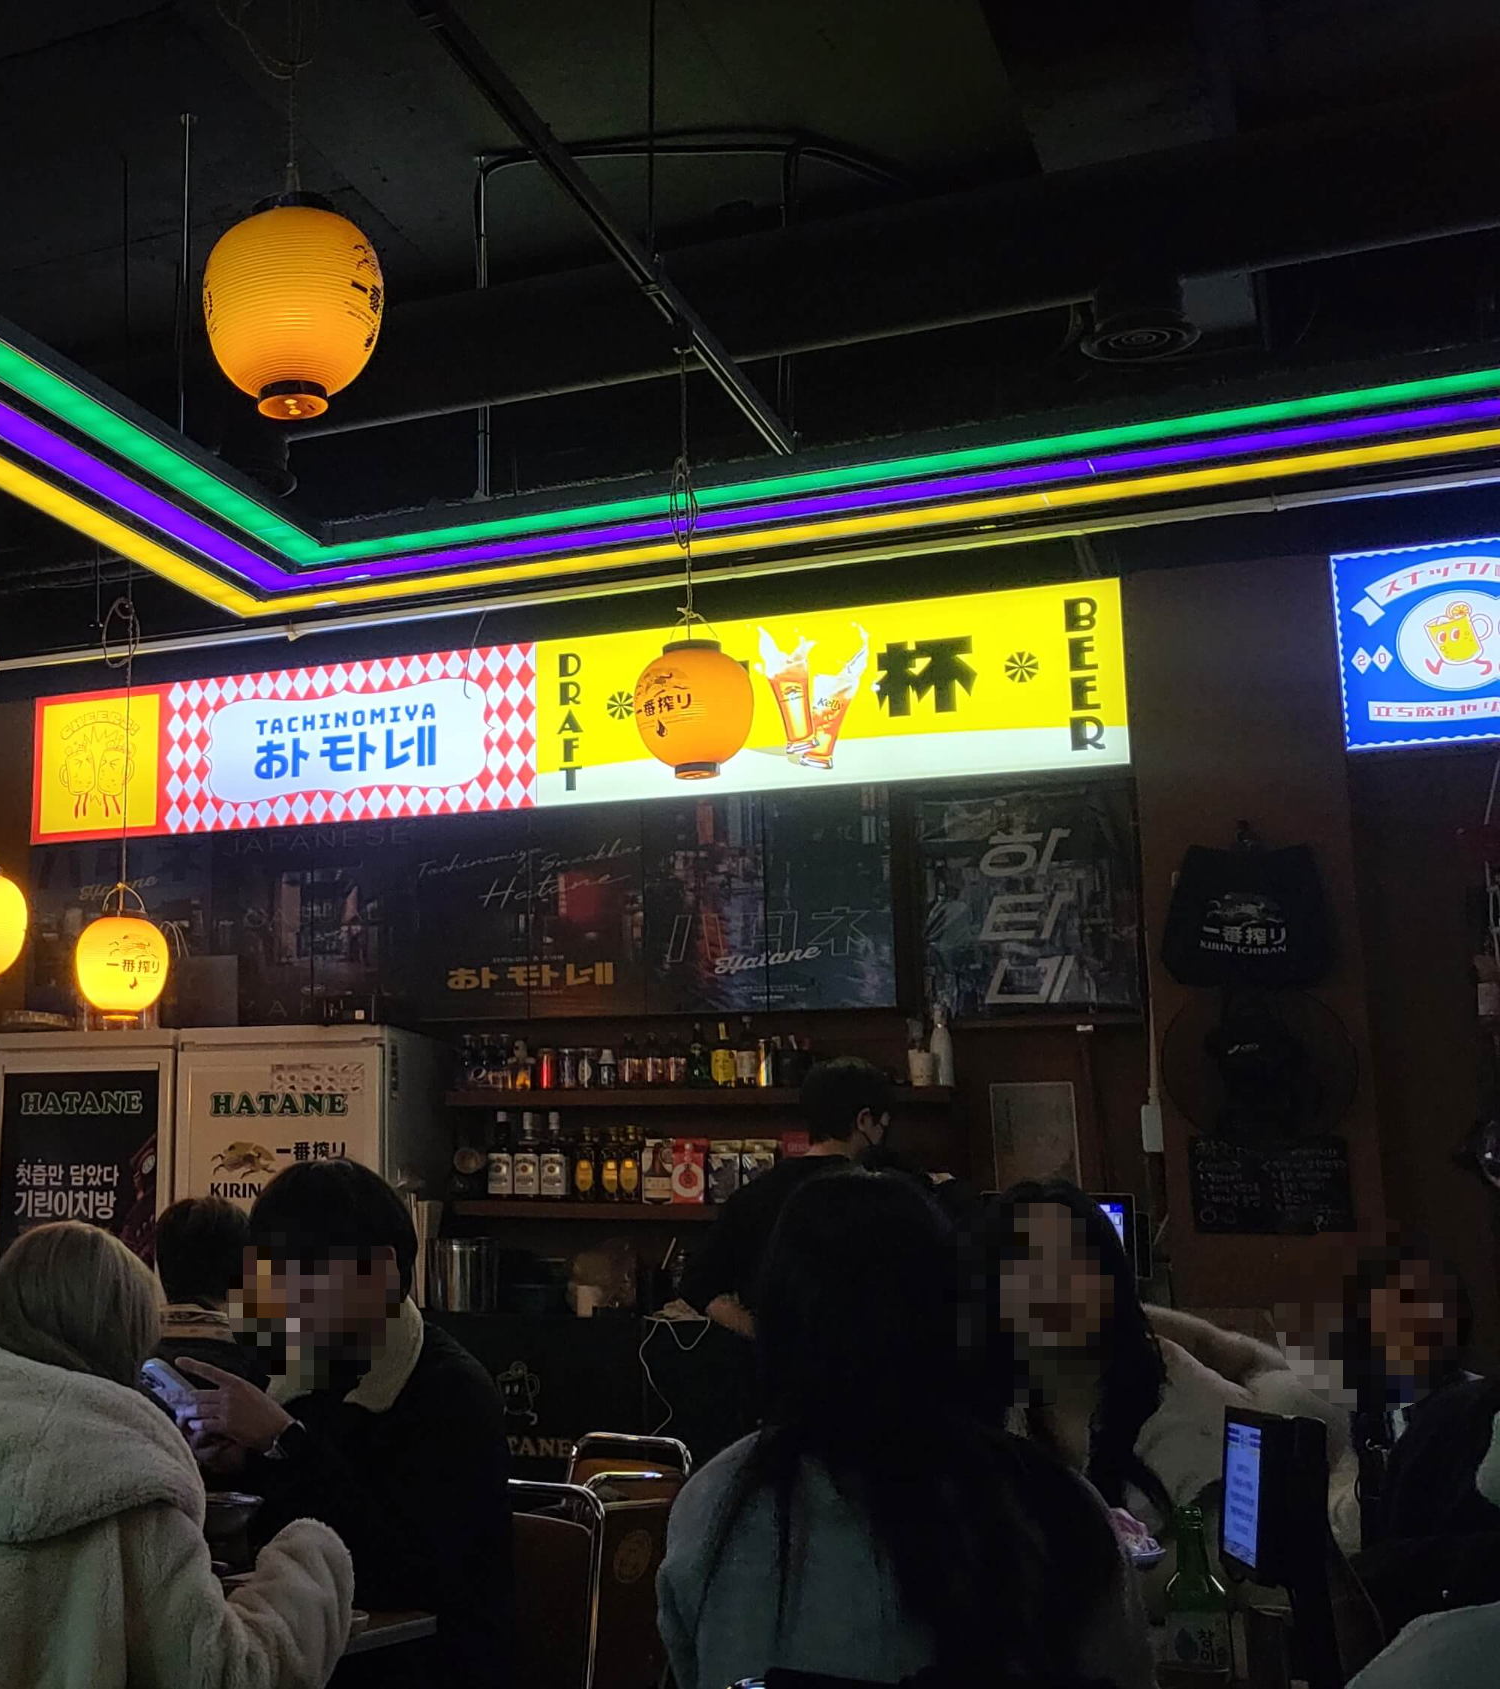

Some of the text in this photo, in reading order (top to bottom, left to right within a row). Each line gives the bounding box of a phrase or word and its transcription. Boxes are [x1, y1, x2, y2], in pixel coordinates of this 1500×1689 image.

[876, 635, 978, 718] 杯
[1064, 597, 1106, 752] BEER
[255, 702, 436, 736] TACHINOMIYA
[558, 653, 584, 791] DRAFT
[1200, 939, 1233, 954] KIRIN
[19, 1090, 144, 1116] HATANE
[210, 1091, 348, 1118] HATANE
[15, 1161, 120, 1189] 첫즙만 담았다
[13, 1189, 118, 1221] 기린이치방
